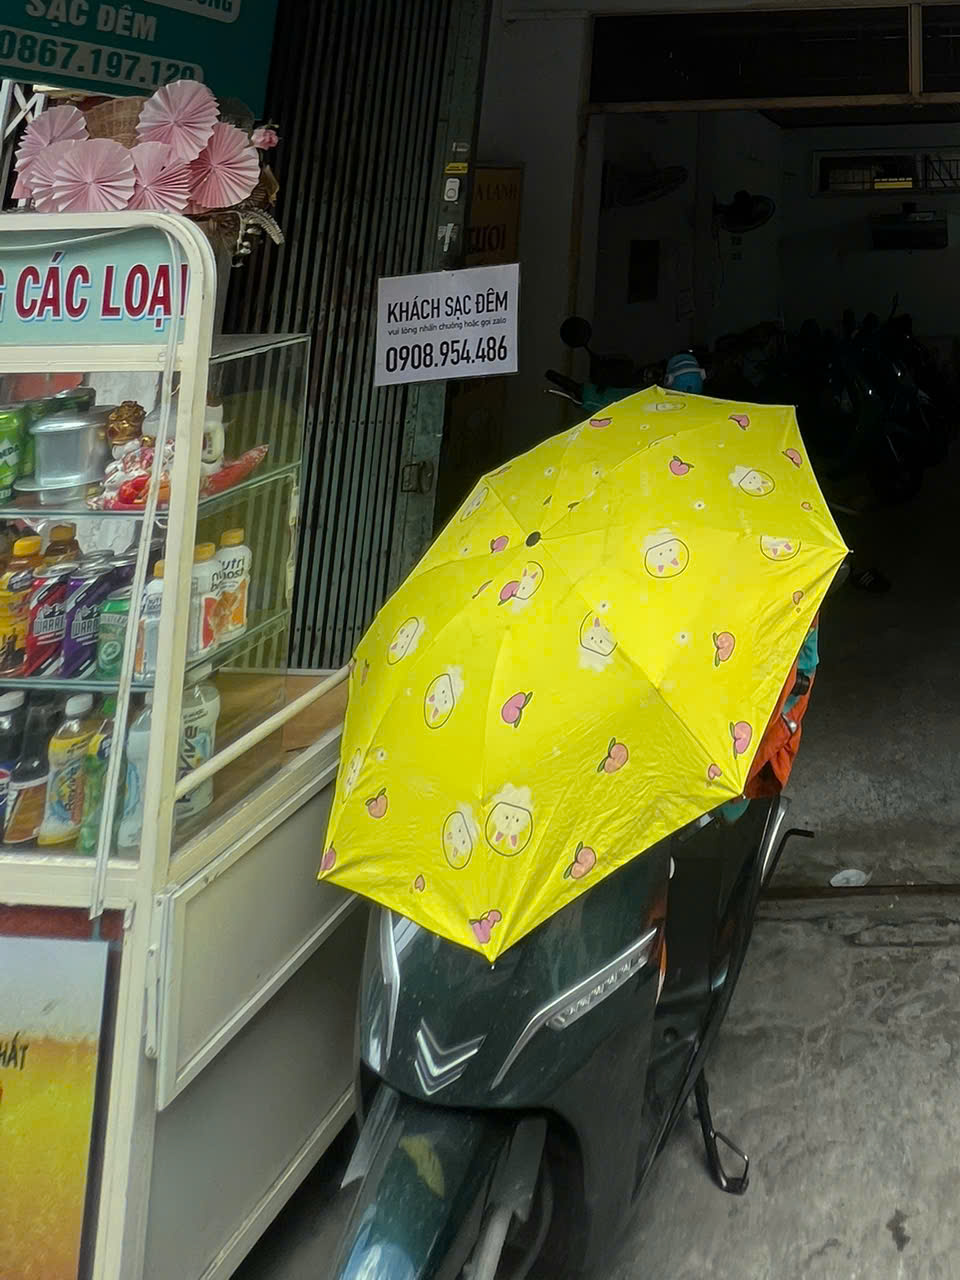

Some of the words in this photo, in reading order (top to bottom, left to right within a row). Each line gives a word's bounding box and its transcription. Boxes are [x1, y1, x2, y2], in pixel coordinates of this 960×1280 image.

[96, 3, 158, 42] ĐÊM
[15, 252, 90, 318] CÁC
[387, 295, 440, 324] KHÁCH
[445, 294, 472, 320] SẠC
[475, 287, 509, 314] ĐÊM
[385, 335, 508, 373] 0908.954.486
